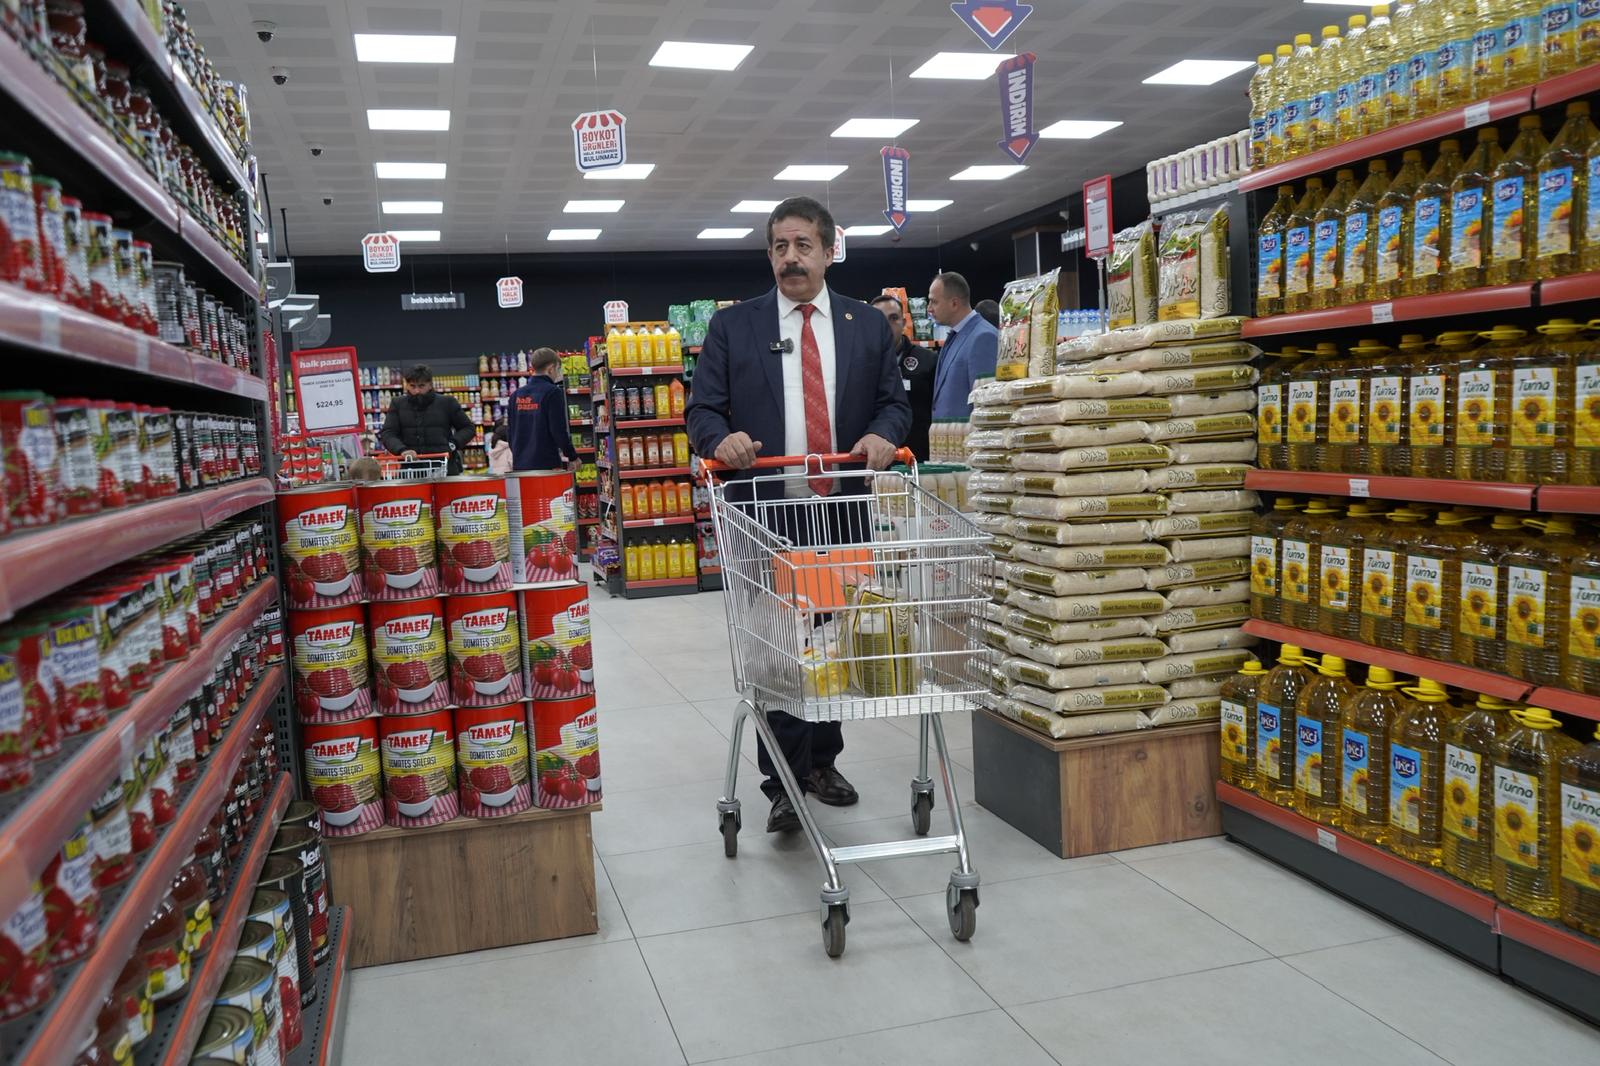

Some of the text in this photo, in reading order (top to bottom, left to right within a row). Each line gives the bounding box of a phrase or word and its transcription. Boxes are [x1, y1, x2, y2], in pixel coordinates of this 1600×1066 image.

[582, 129, 616, 142] BOYKOT
[582, 140, 617, 151] ÜRÜNLERİ
[583, 153, 619, 162] BULUNMAZ
[369, 245, 394, 253] BOYKOT
[411, 296, 433, 304] bebek
[300, 360, 319, 369] halk
[1374, 385, 1398, 397] Turna
[1414, 384, 1439, 396] Turna
[1463, 381, 1490, 394] Turna
[1518, 378, 1551, 392] Turna
[1292, 388, 1314, 400] Turna
[1333, 386, 1356, 399] Turna
[375, 504, 417, 519] TAMEK
[453, 499, 495, 514] TAMEK
[300, 508, 344, 526] TAMEK
[374, 529, 401, 540] DOMATES
[452, 523, 479, 534] DOMATES
[300, 537, 330, 548] DOMATES
[1254, 543, 1273, 555] Turna
[1286, 547, 1306, 560] Turna
[1324, 553, 1346, 567] Turna
[1367, 556, 1391, 570] Turna
[1411, 564, 1438, 579] Turna
[1466, 571, 1493, 587] Turna
[1512, 576, 1541, 592] Turna
[387, 619, 429, 634] TAMEK
[464, 612, 505, 628] TAMEK
[307, 626, 350, 642] TAMEK
[463, 636, 490, 648] DOMATES
[386, 644, 413, 656] DOMATES
[307, 652, 335, 663] DOMATES
[1223, 707, 1243, 722] Turna
[470, 725, 511, 740] TAMEK
[388, 734, 428, 749] TAMEK
[313, 742, 355, 758] TAMEK
[470, 750, 495, 761] DOMATES
[388, 758, 412, 769] DOMATES
[1448, 753, 1476, 775] Turna
[313, 766, 338, 777] DOMATES
[1499, 775, 1534, 799] Turna
